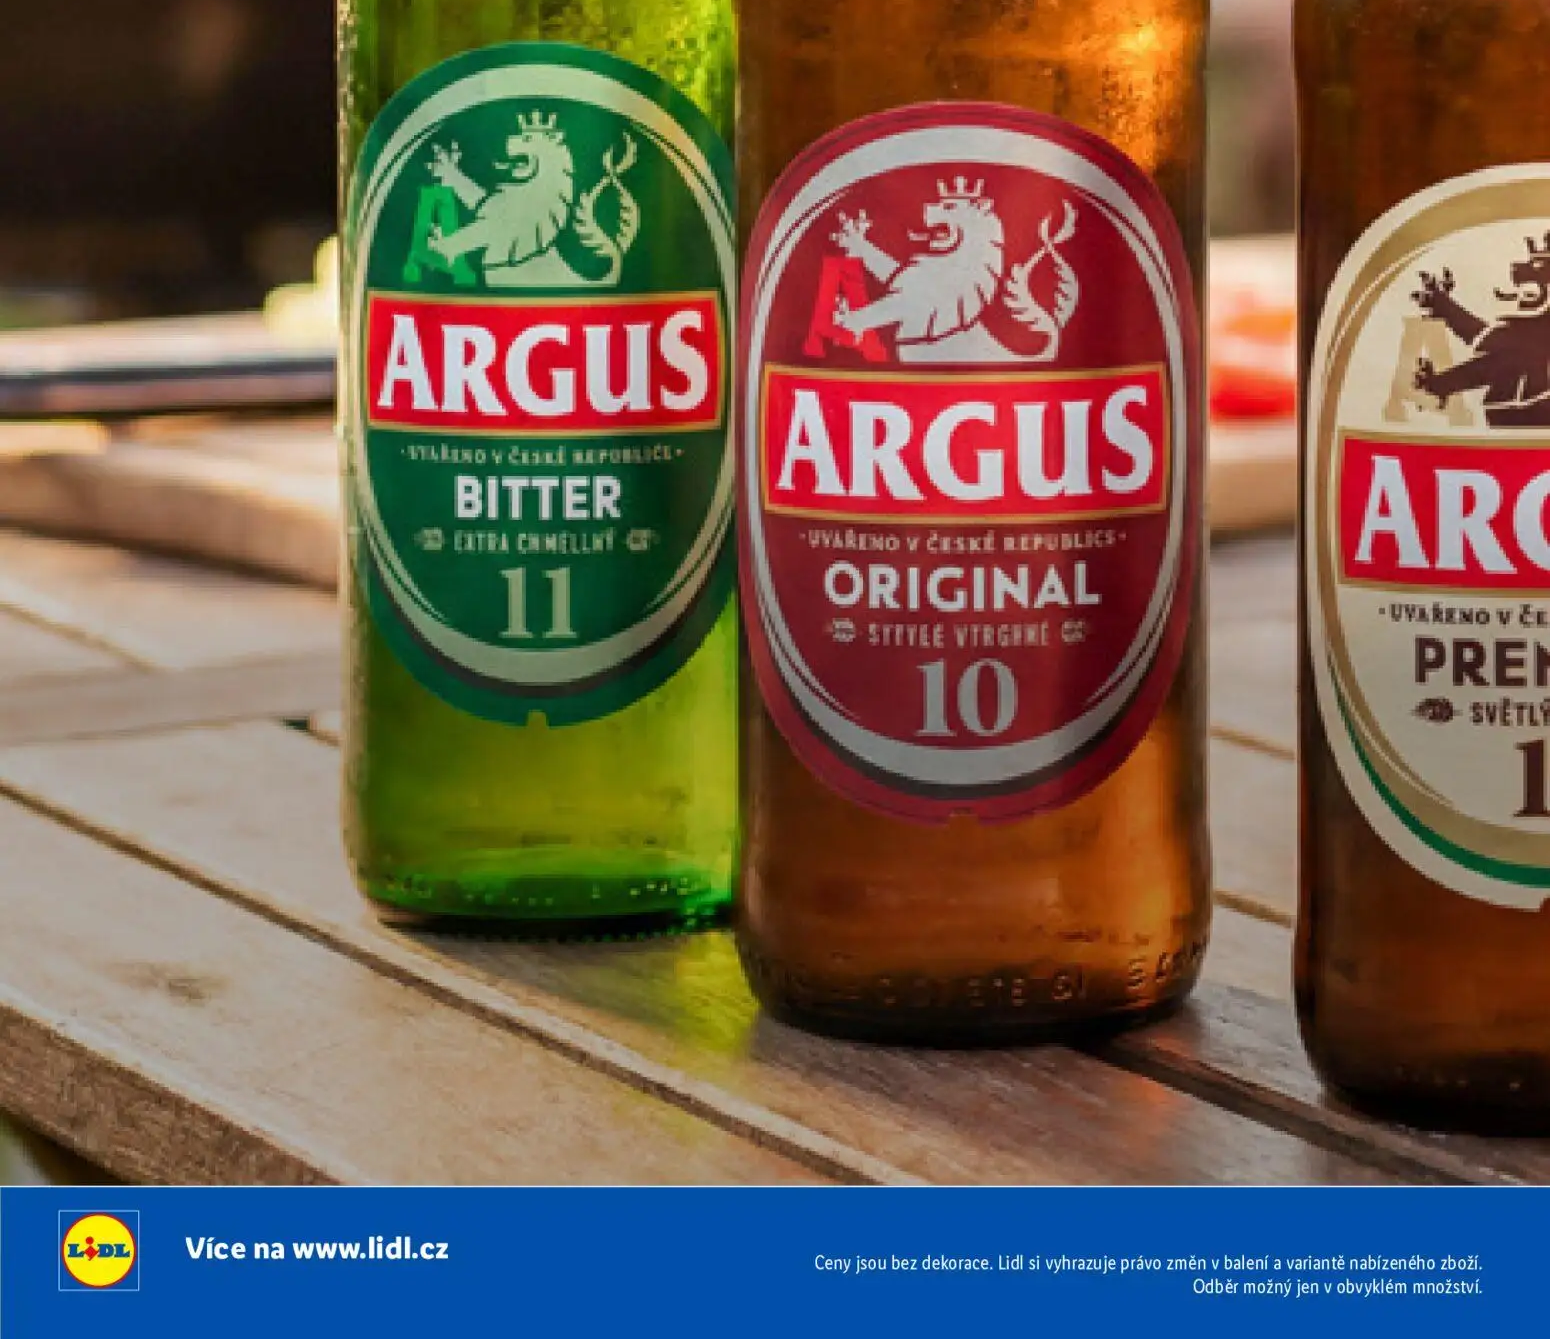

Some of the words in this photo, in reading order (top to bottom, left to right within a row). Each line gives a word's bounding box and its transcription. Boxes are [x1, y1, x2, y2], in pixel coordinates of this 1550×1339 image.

[377, 310, 709, 417] ARGUS
[776, 384, 1156, 502] ARGUS
[454, 475, 623, 521] BITTER
[499, 567, 578, 640] 11
[824, 560, 1103, 612] ORIGINAL
[1495, 608, 1512, 626] V
[915, 657, 1019, 738] 10
